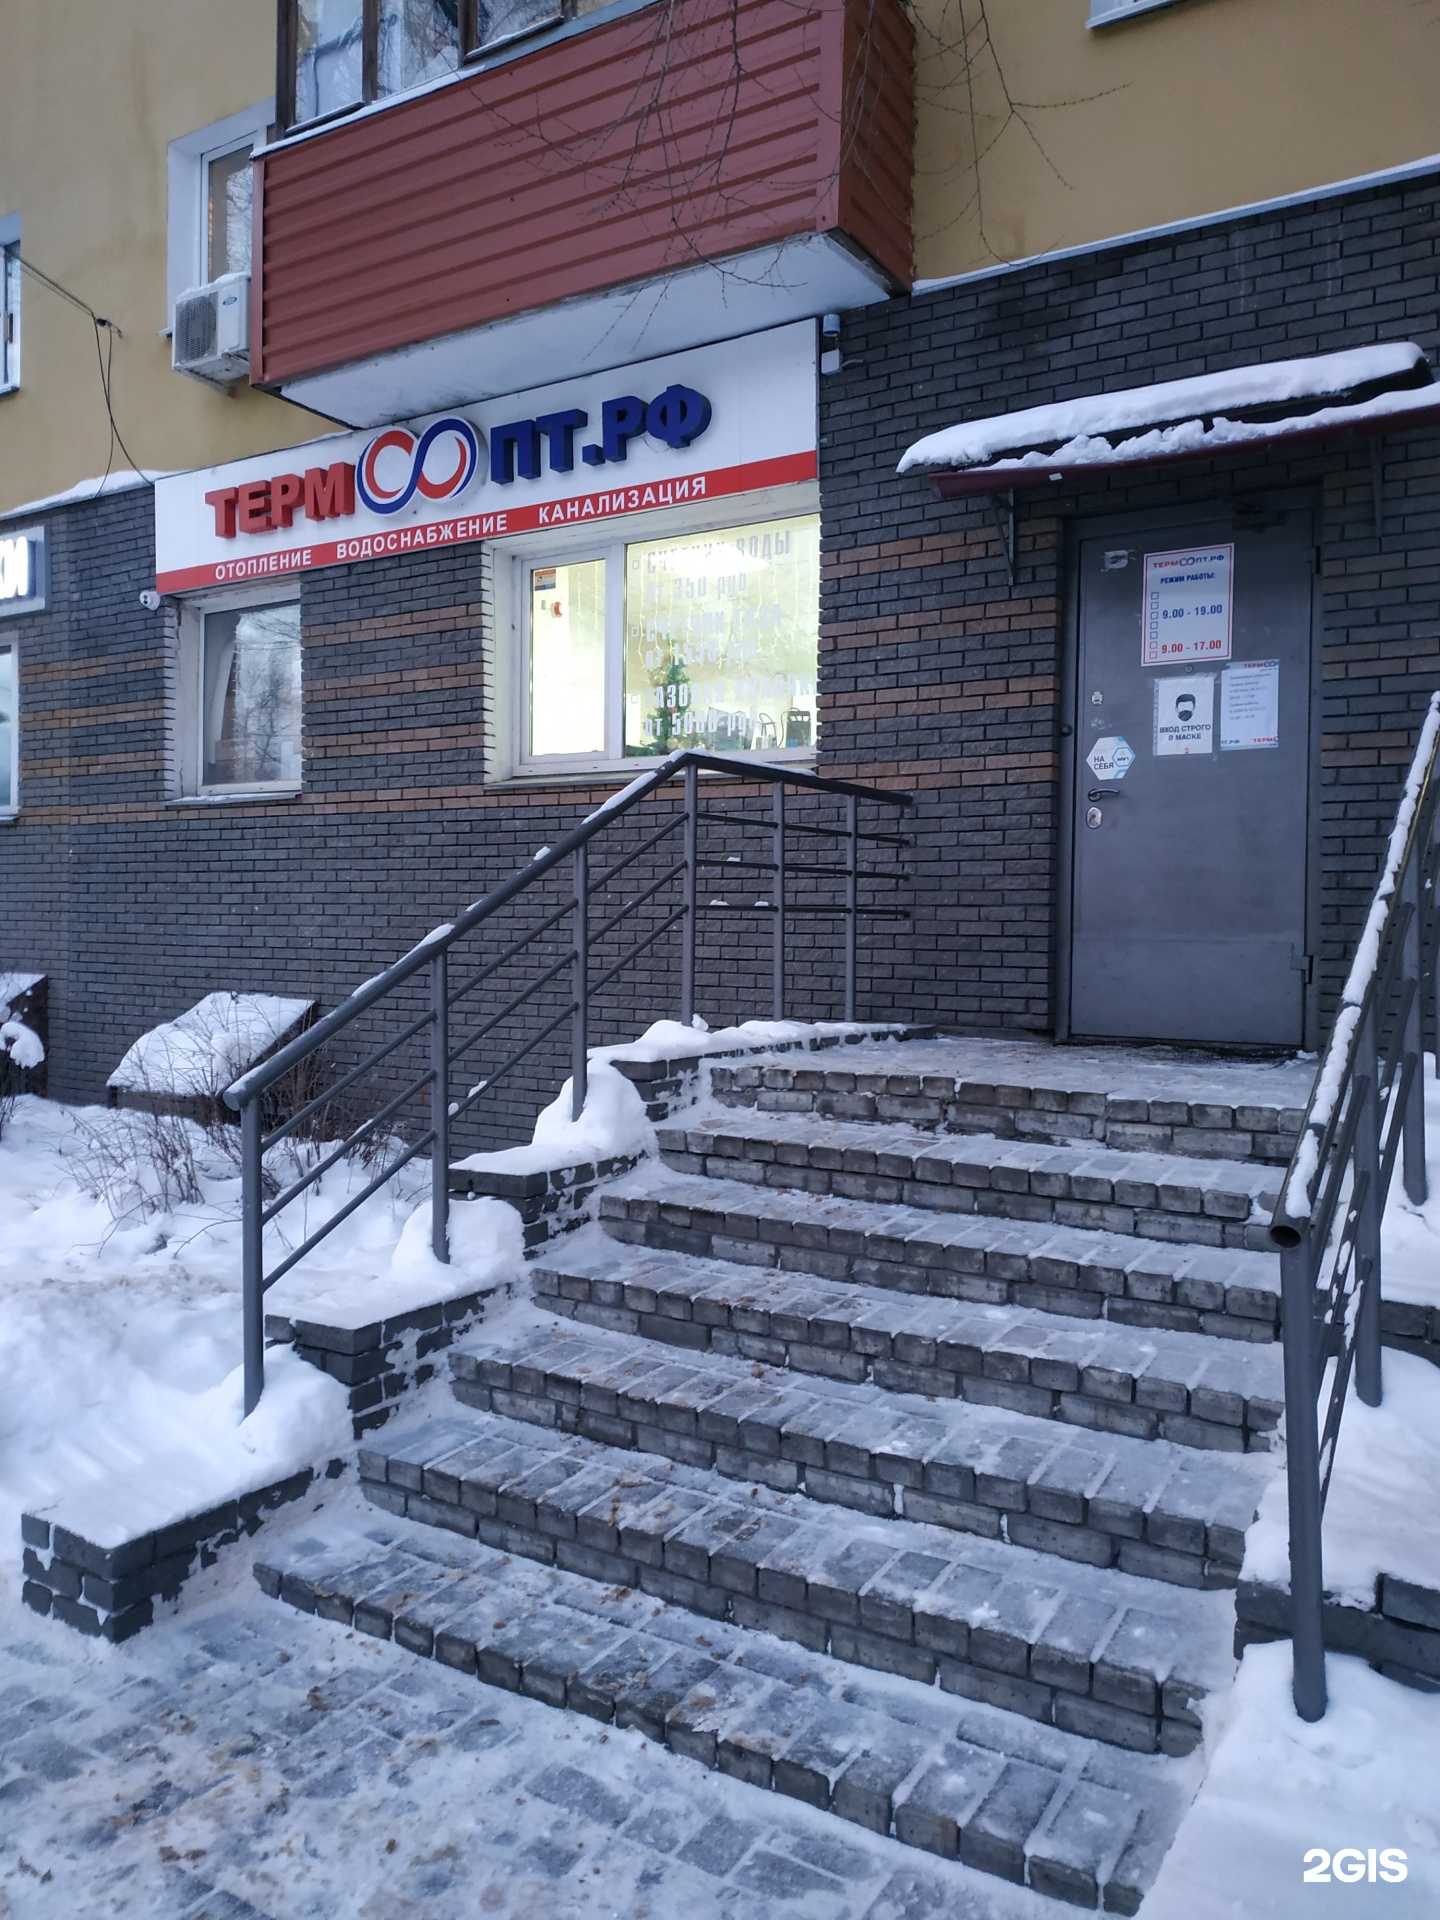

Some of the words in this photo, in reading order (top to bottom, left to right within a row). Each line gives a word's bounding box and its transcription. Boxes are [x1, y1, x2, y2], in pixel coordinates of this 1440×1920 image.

[214, 549, 313, 580] ОТОПЛЕНИЕ
[336, 513, 508, 561] ВОДОСНАБЖЕНИЕ
[538, 475, 707, 525] КАНАЛИЗАЦИЯ
[1162, 608, 1184, 619] 9.00
[1195, 604, 1223, 616] 19.00
[1161, 643, 1184, 654] 9.00
[1194, 640, 1222, 651] 17.00
[1181, 724, 1211, 732] СТРОГО
[1093, 755, 1105, 763] НА
[1093, 762, 1114, 770] СЕБЯ
